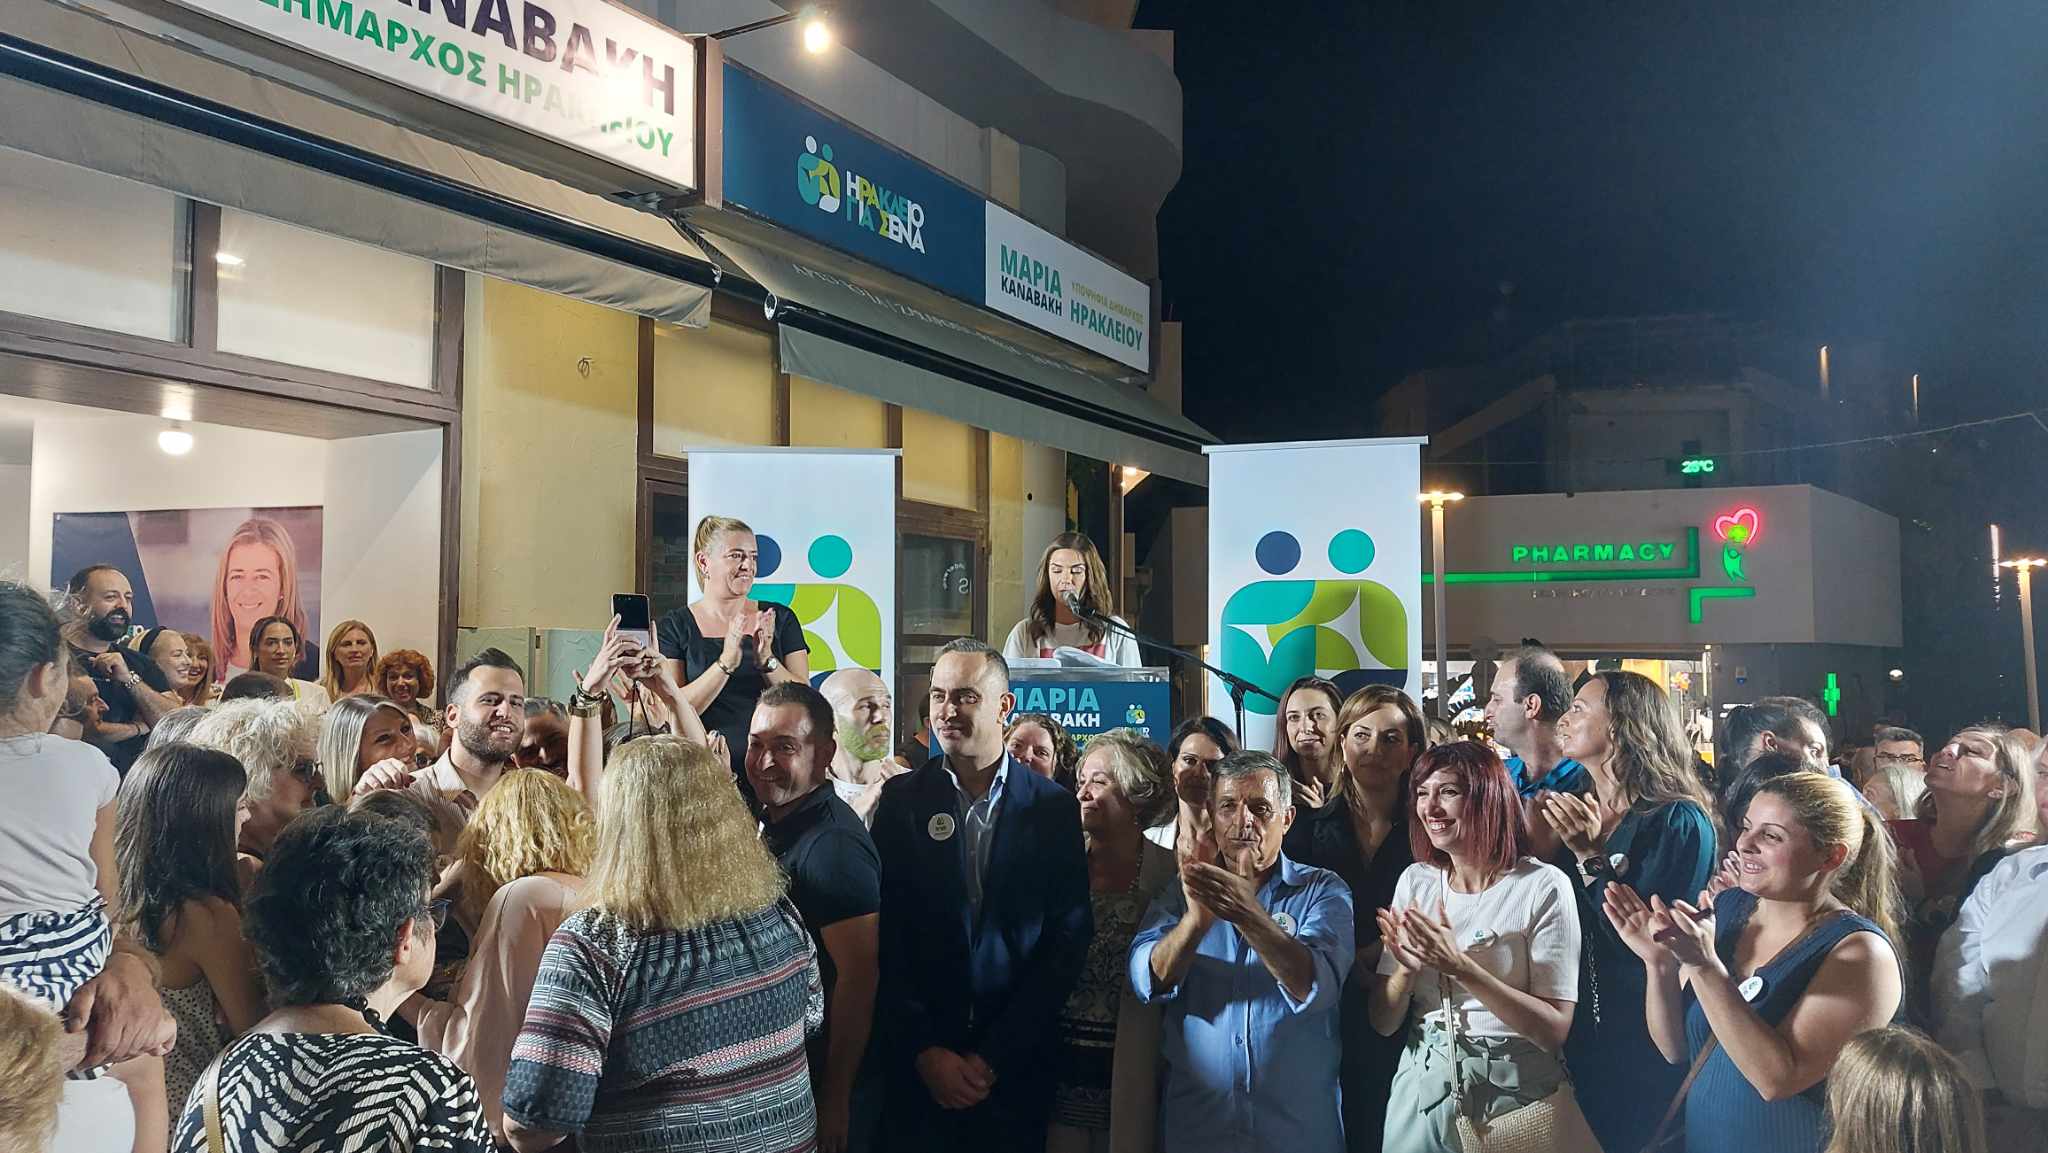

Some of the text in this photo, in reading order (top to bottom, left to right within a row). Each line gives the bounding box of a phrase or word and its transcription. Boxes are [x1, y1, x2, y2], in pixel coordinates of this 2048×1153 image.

[258, 0, 673, 158] ΗΜΑΡΧΟΣ ΗΡΑΚΟΥ
[846, 170, 925, 229] ΗΡΑΚΛΕΙΟ
[846, 195, 926, 255] ΓΙΑ ΣΕΝΑ
[1000, 244, 1062, 298] ΜΑΡΙΑ
[1001, 275, 1063, 316] ΚΑΝΑΒΑΚΗ
[1070, 299, 1143, 351] ΗΡΑΚΛΕΙΟΥ
[1512, 543, 1674, 562] PHARMACY
